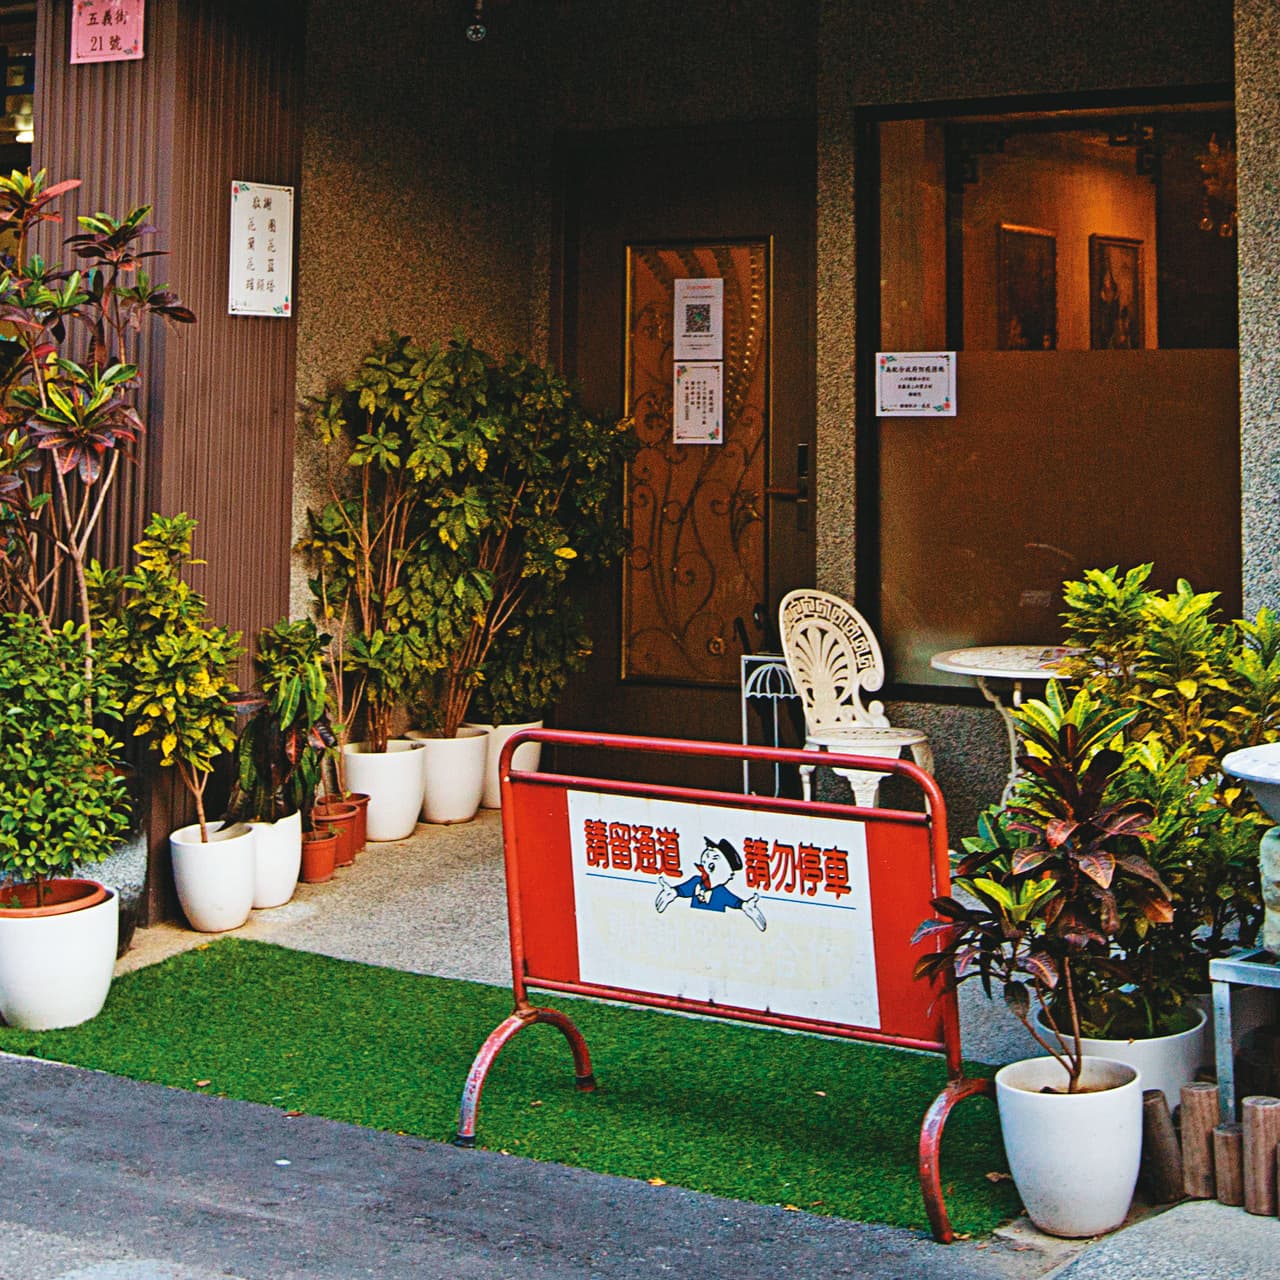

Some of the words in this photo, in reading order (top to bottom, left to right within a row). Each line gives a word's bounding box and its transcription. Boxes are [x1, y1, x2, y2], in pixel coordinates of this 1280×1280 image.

[584, 818, 683, 878] 請留通道
[744, 837, 852, 900] 請勿停車
